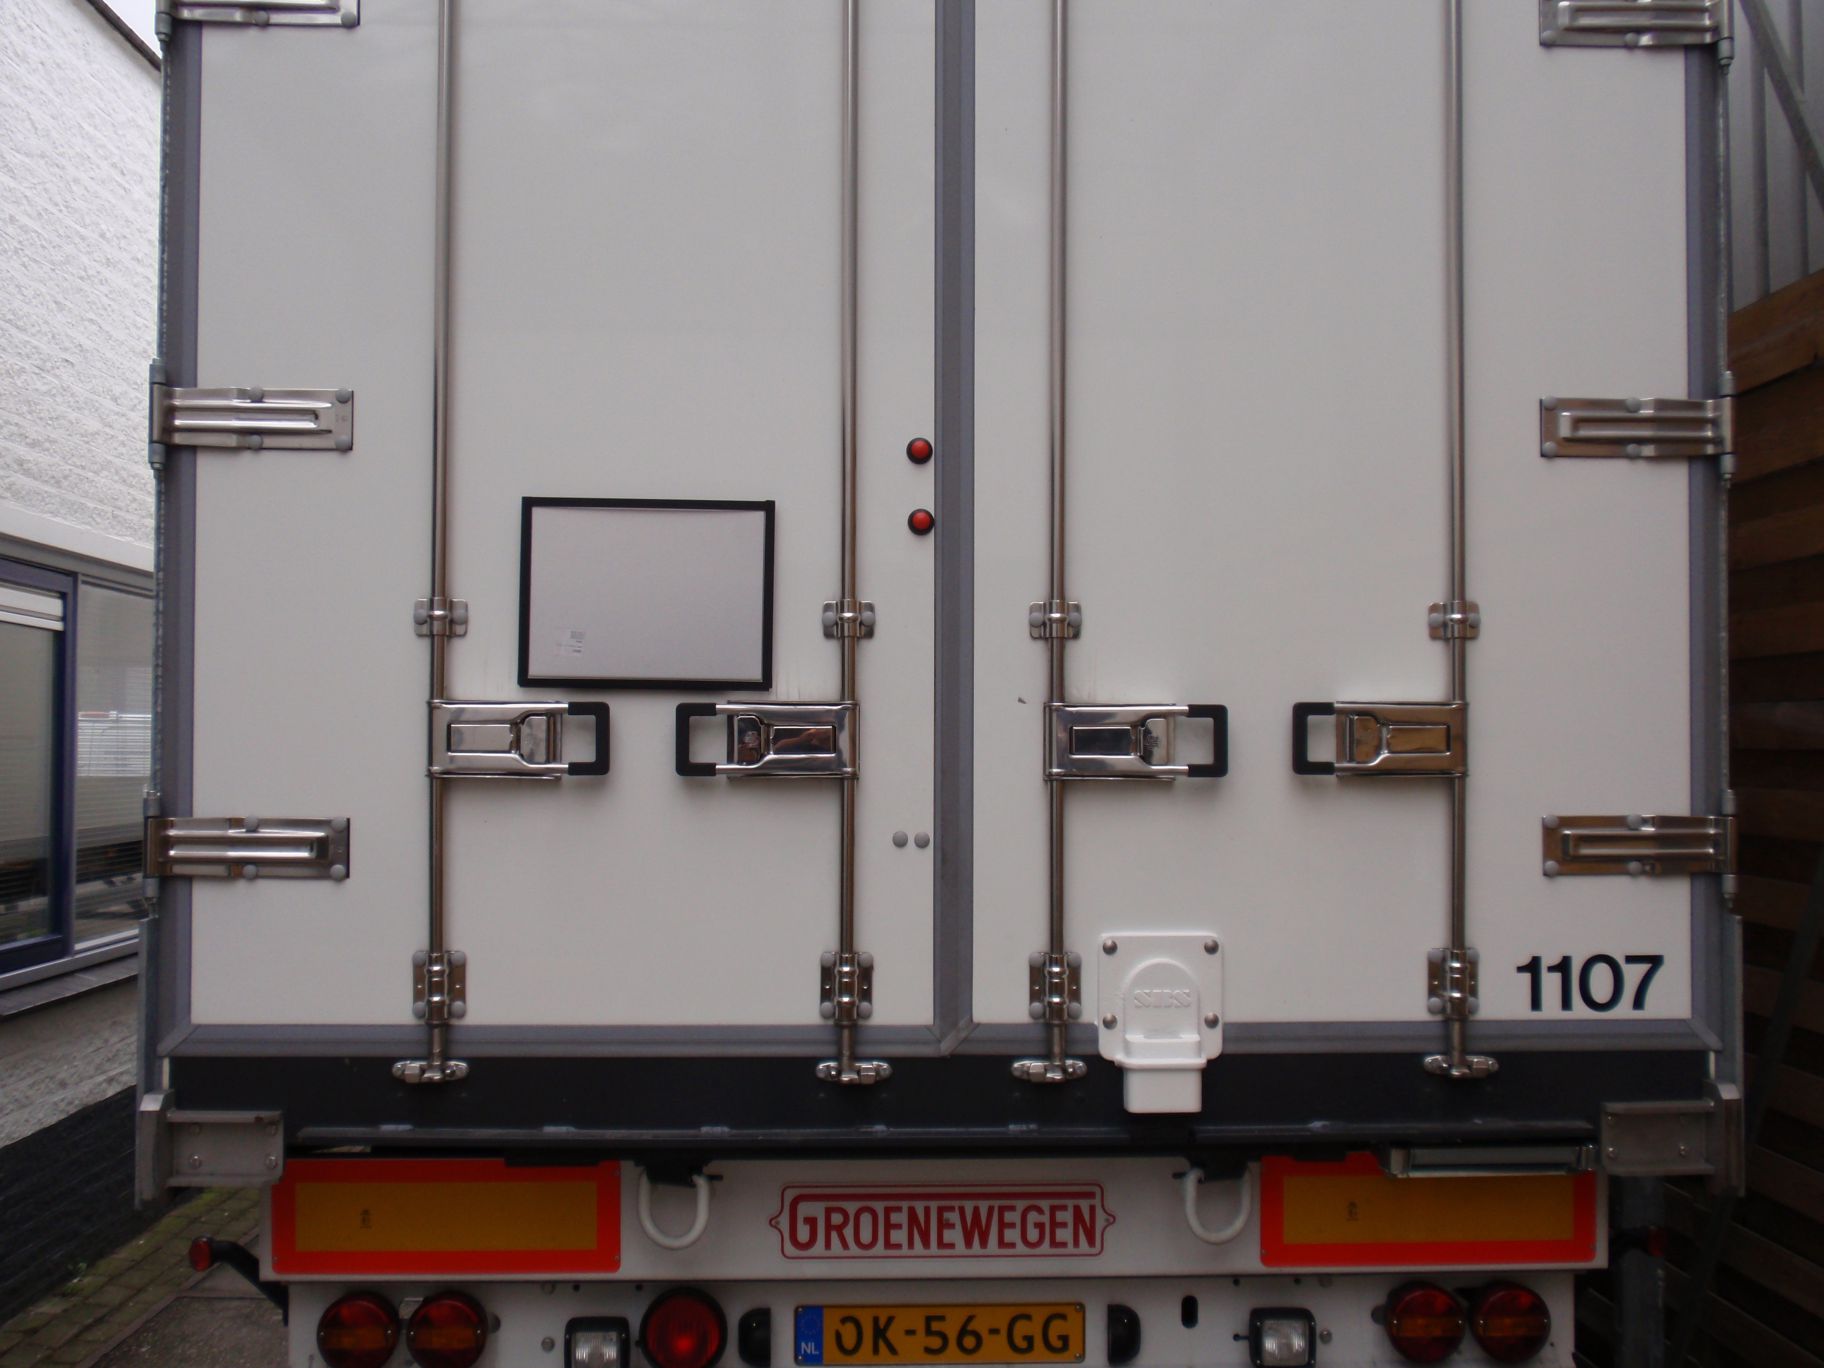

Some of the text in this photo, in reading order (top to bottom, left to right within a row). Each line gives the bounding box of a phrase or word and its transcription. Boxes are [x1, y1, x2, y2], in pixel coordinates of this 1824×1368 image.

[1516, 953, 1665, 1013] 1107
[789, 1191, 1097, 1252] GROENEWEGEN
[801, 1341, 819, 1355] NL
[834, 1312, 1070, 1356] OK-56-GG
